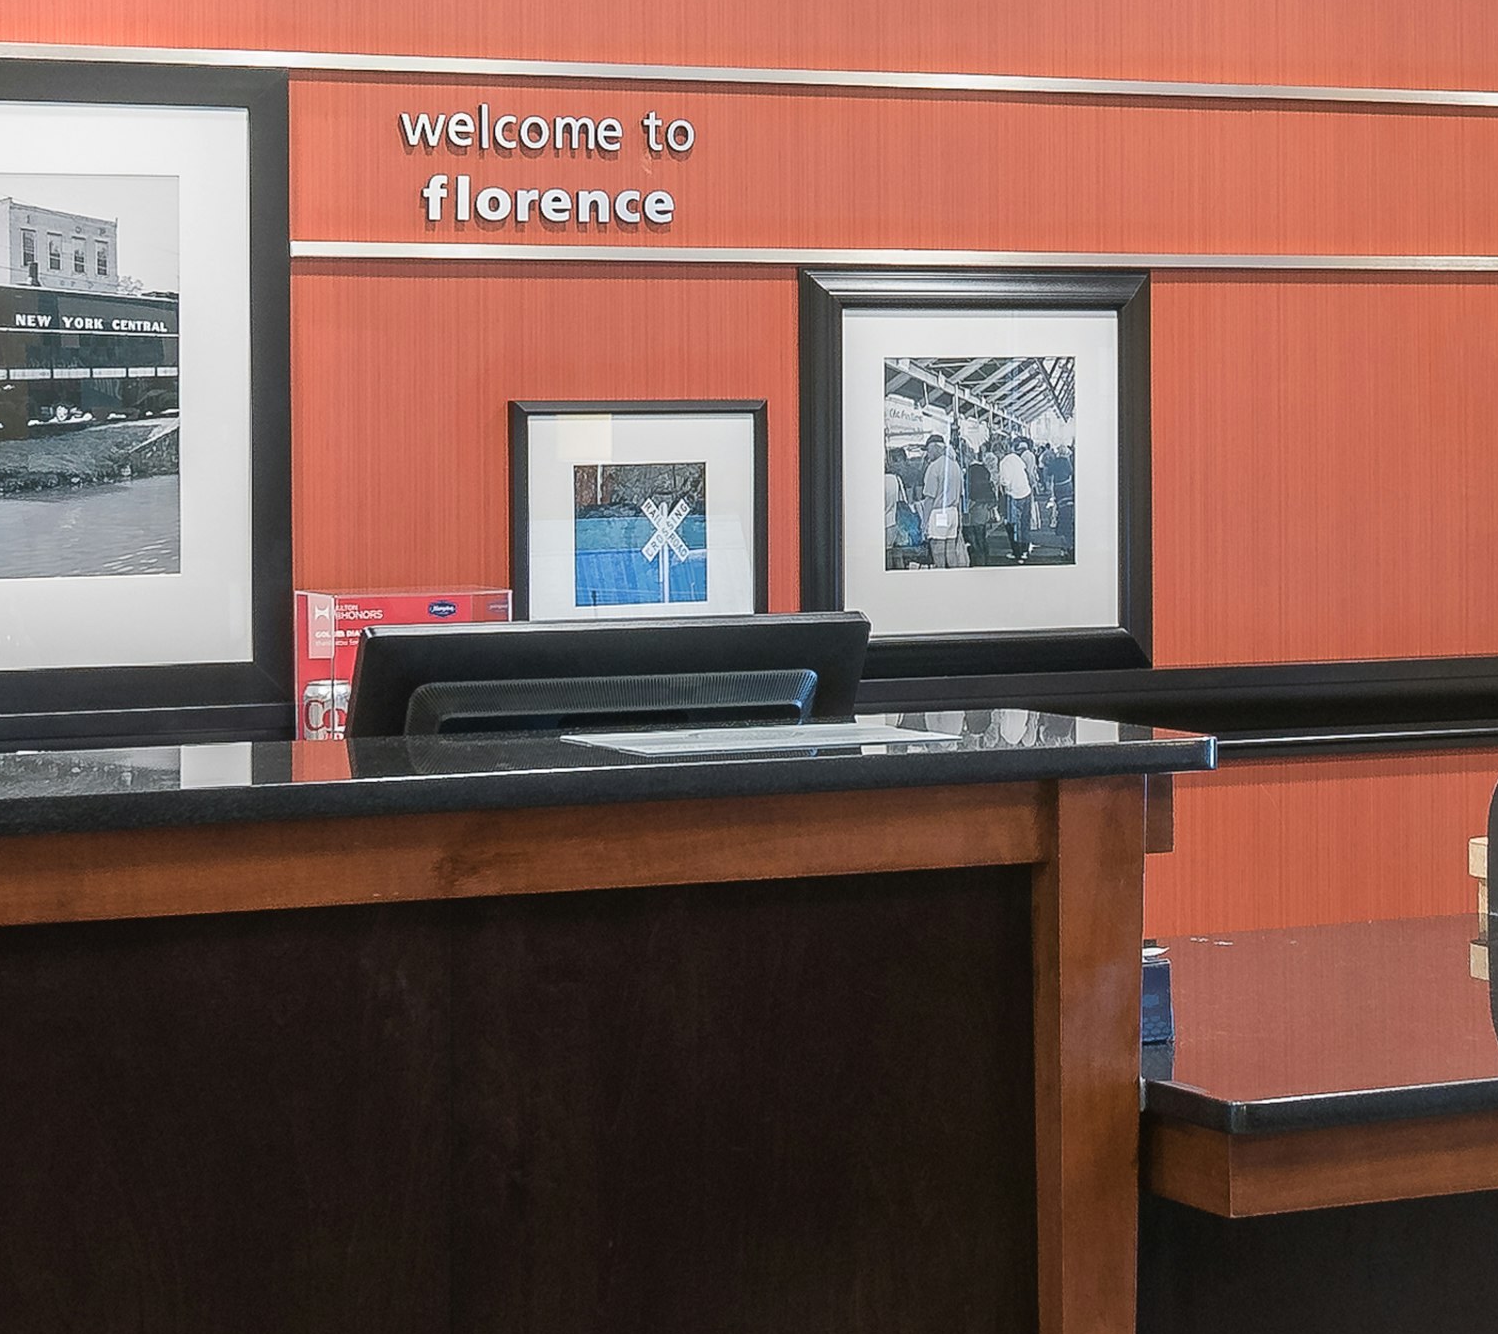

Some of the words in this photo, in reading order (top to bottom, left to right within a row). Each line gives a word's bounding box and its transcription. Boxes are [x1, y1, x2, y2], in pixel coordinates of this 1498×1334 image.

[399, 103, 623, 152] welcome
[642, 111, 696, 152] to
[421, 174, 675, 224] florence
[15, 313, 52, 328] NEW
[62, 315, 104, 330] YORK
[111, 318, 168, 333] CENTRAL
